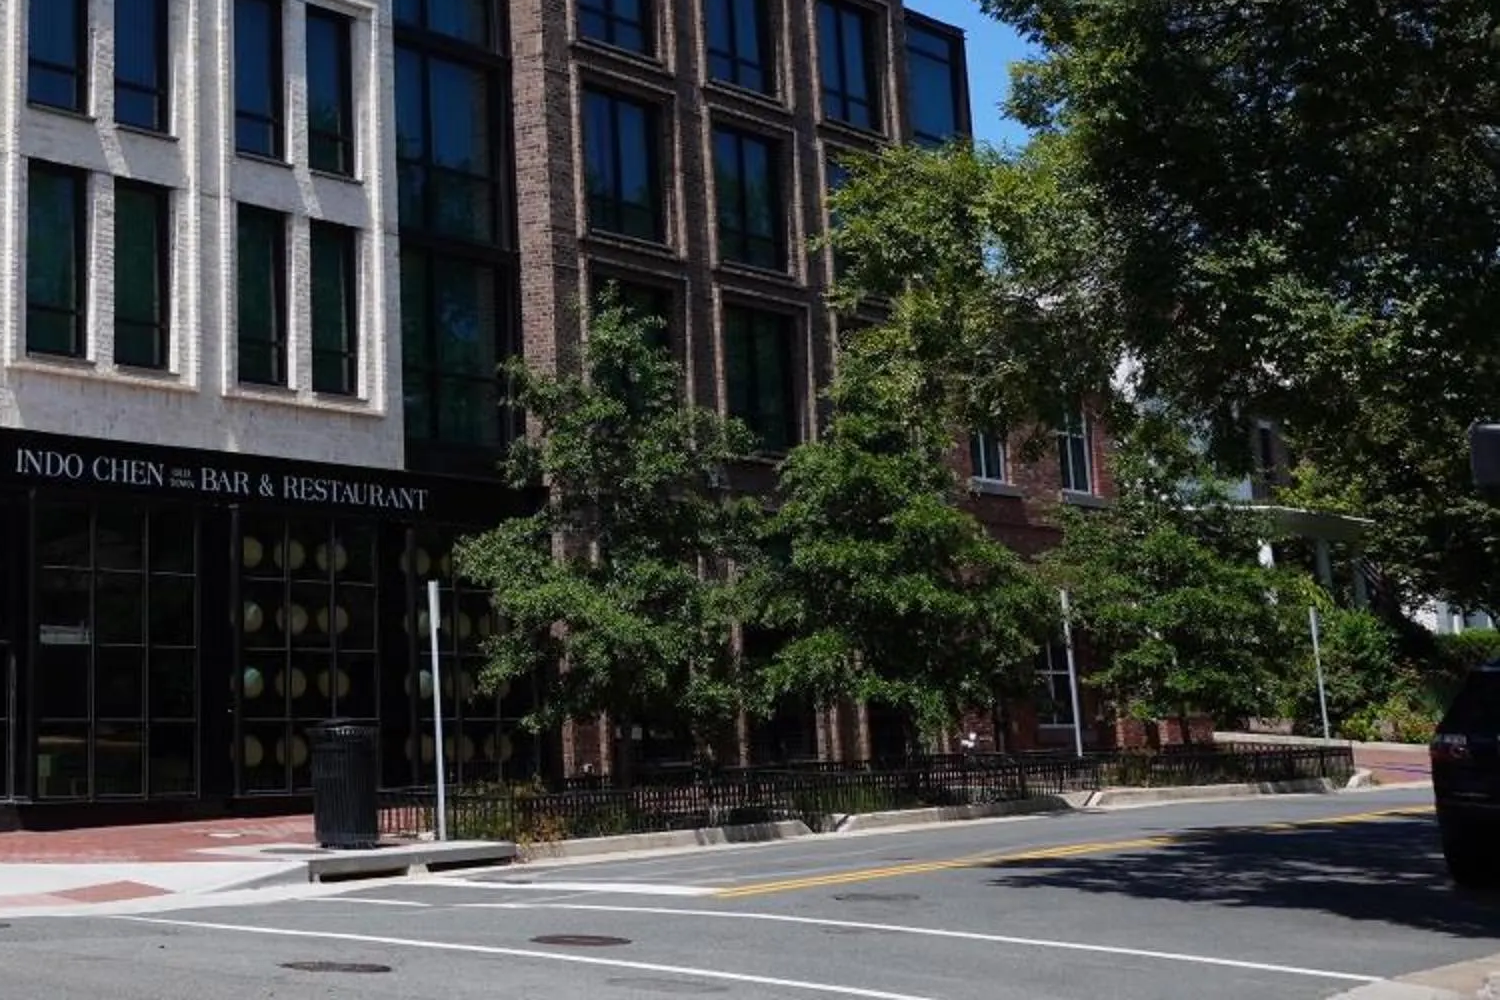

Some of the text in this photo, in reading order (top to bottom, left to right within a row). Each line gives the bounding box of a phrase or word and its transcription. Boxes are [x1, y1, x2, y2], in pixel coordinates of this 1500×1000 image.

[15, 448, 429, 511] INDO CHEN BAR & RESTAURANT
